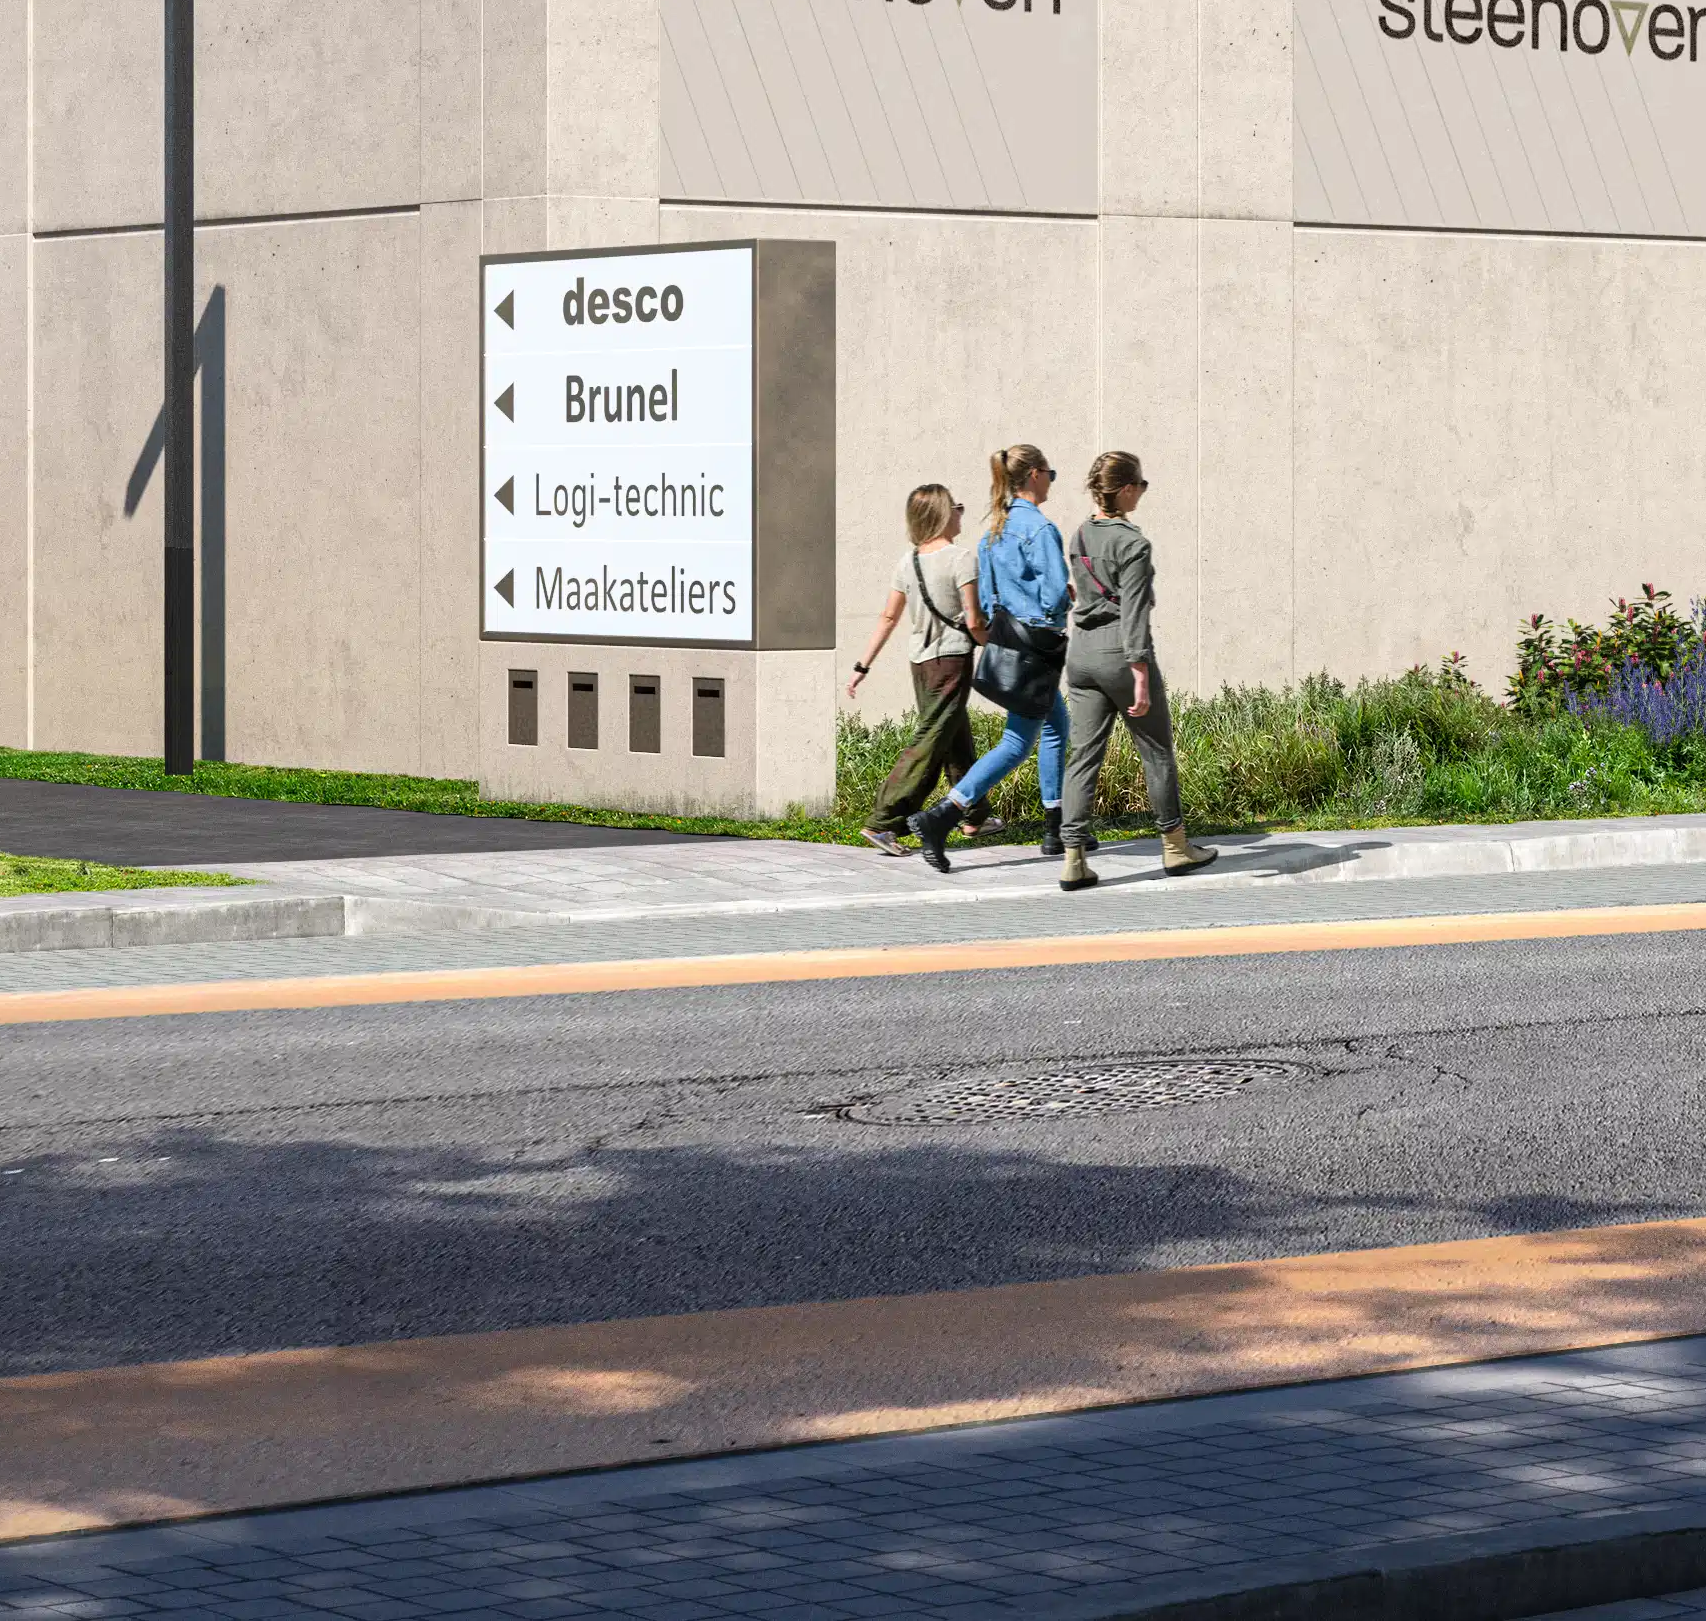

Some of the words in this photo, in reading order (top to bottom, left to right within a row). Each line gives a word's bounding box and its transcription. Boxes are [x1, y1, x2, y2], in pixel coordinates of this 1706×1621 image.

[562, 276, 684, 326] desco
[565, 368, 678, 423] Brunel
[535, 472, 725, 529] Logi-technic
[535, 564, 736, 615] Maakateliers
